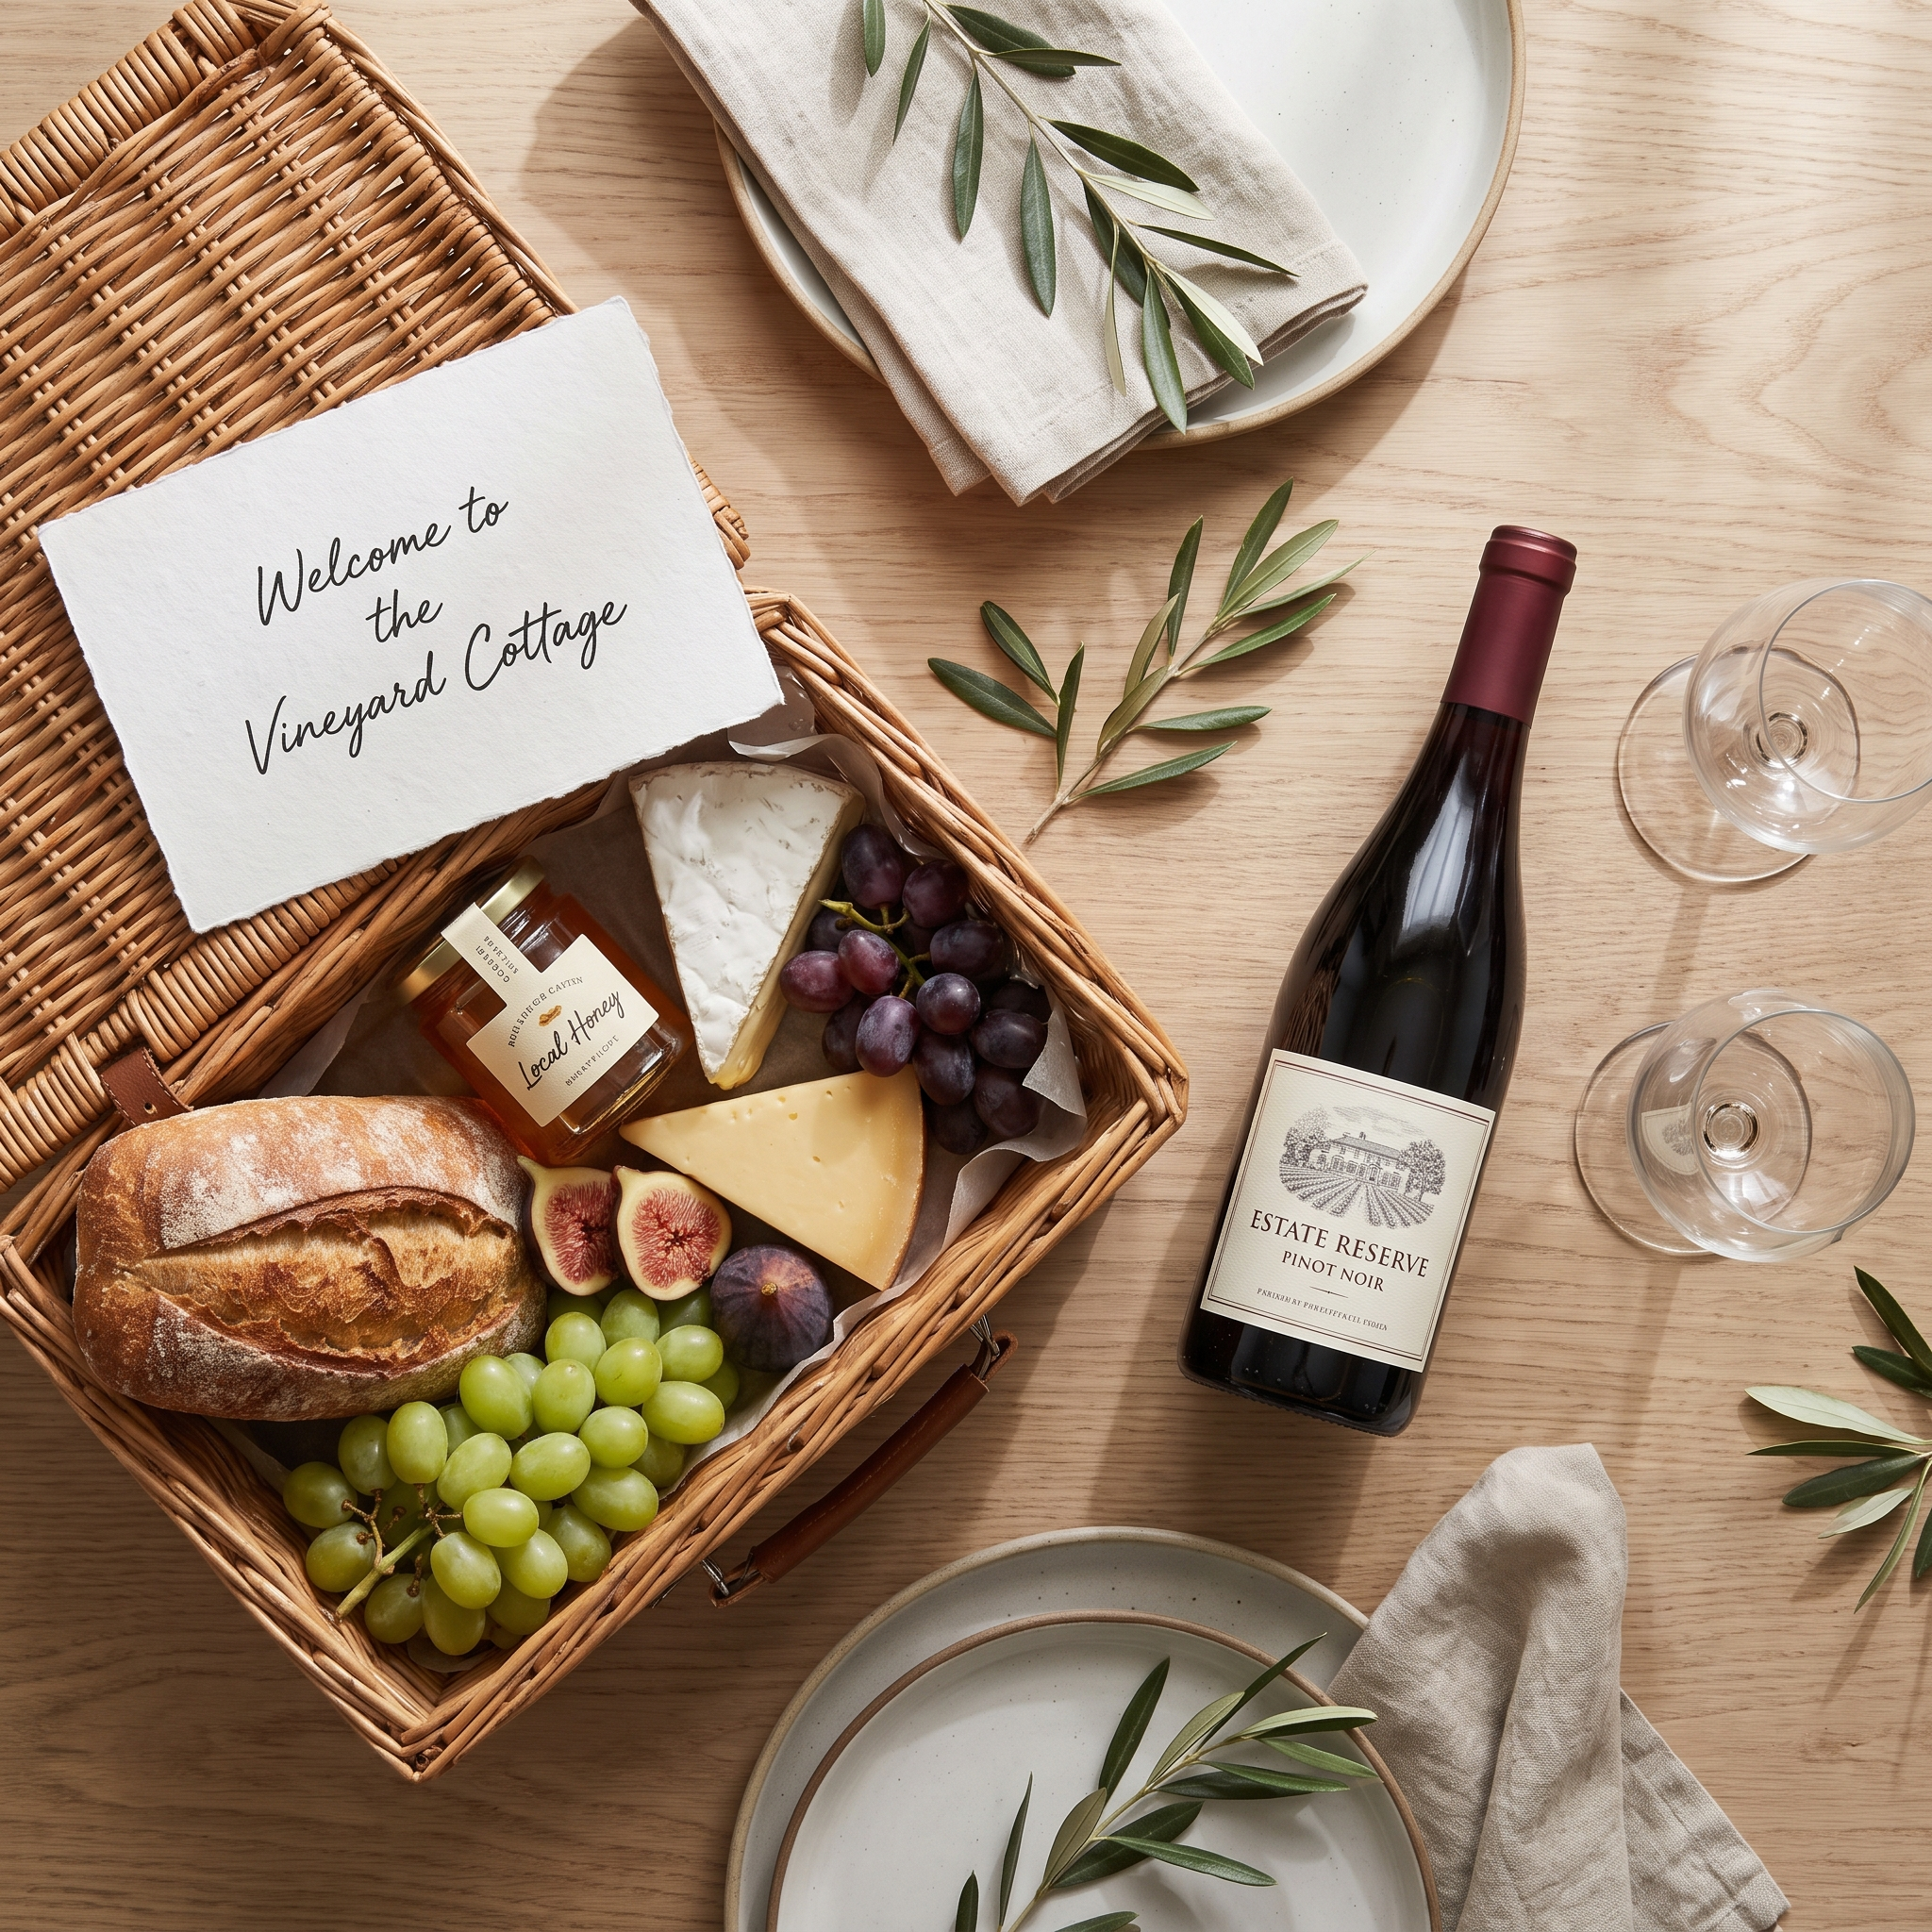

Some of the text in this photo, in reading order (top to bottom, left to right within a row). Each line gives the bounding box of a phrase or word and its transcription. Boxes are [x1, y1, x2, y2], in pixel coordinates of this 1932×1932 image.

[258, 486, 509, 626] Welcome to
[365, 589, 443, 643] the
[244, 601, 628, 775] Vineyard Cottage
[518, 1030, 568, 1091] Local
[567, 991, 625, 1045] Honey
[1249, 1208, 1429, 1278] ESTATE RESERVE
[1281, 1250, 1384, 1292] PINOT NOIR
